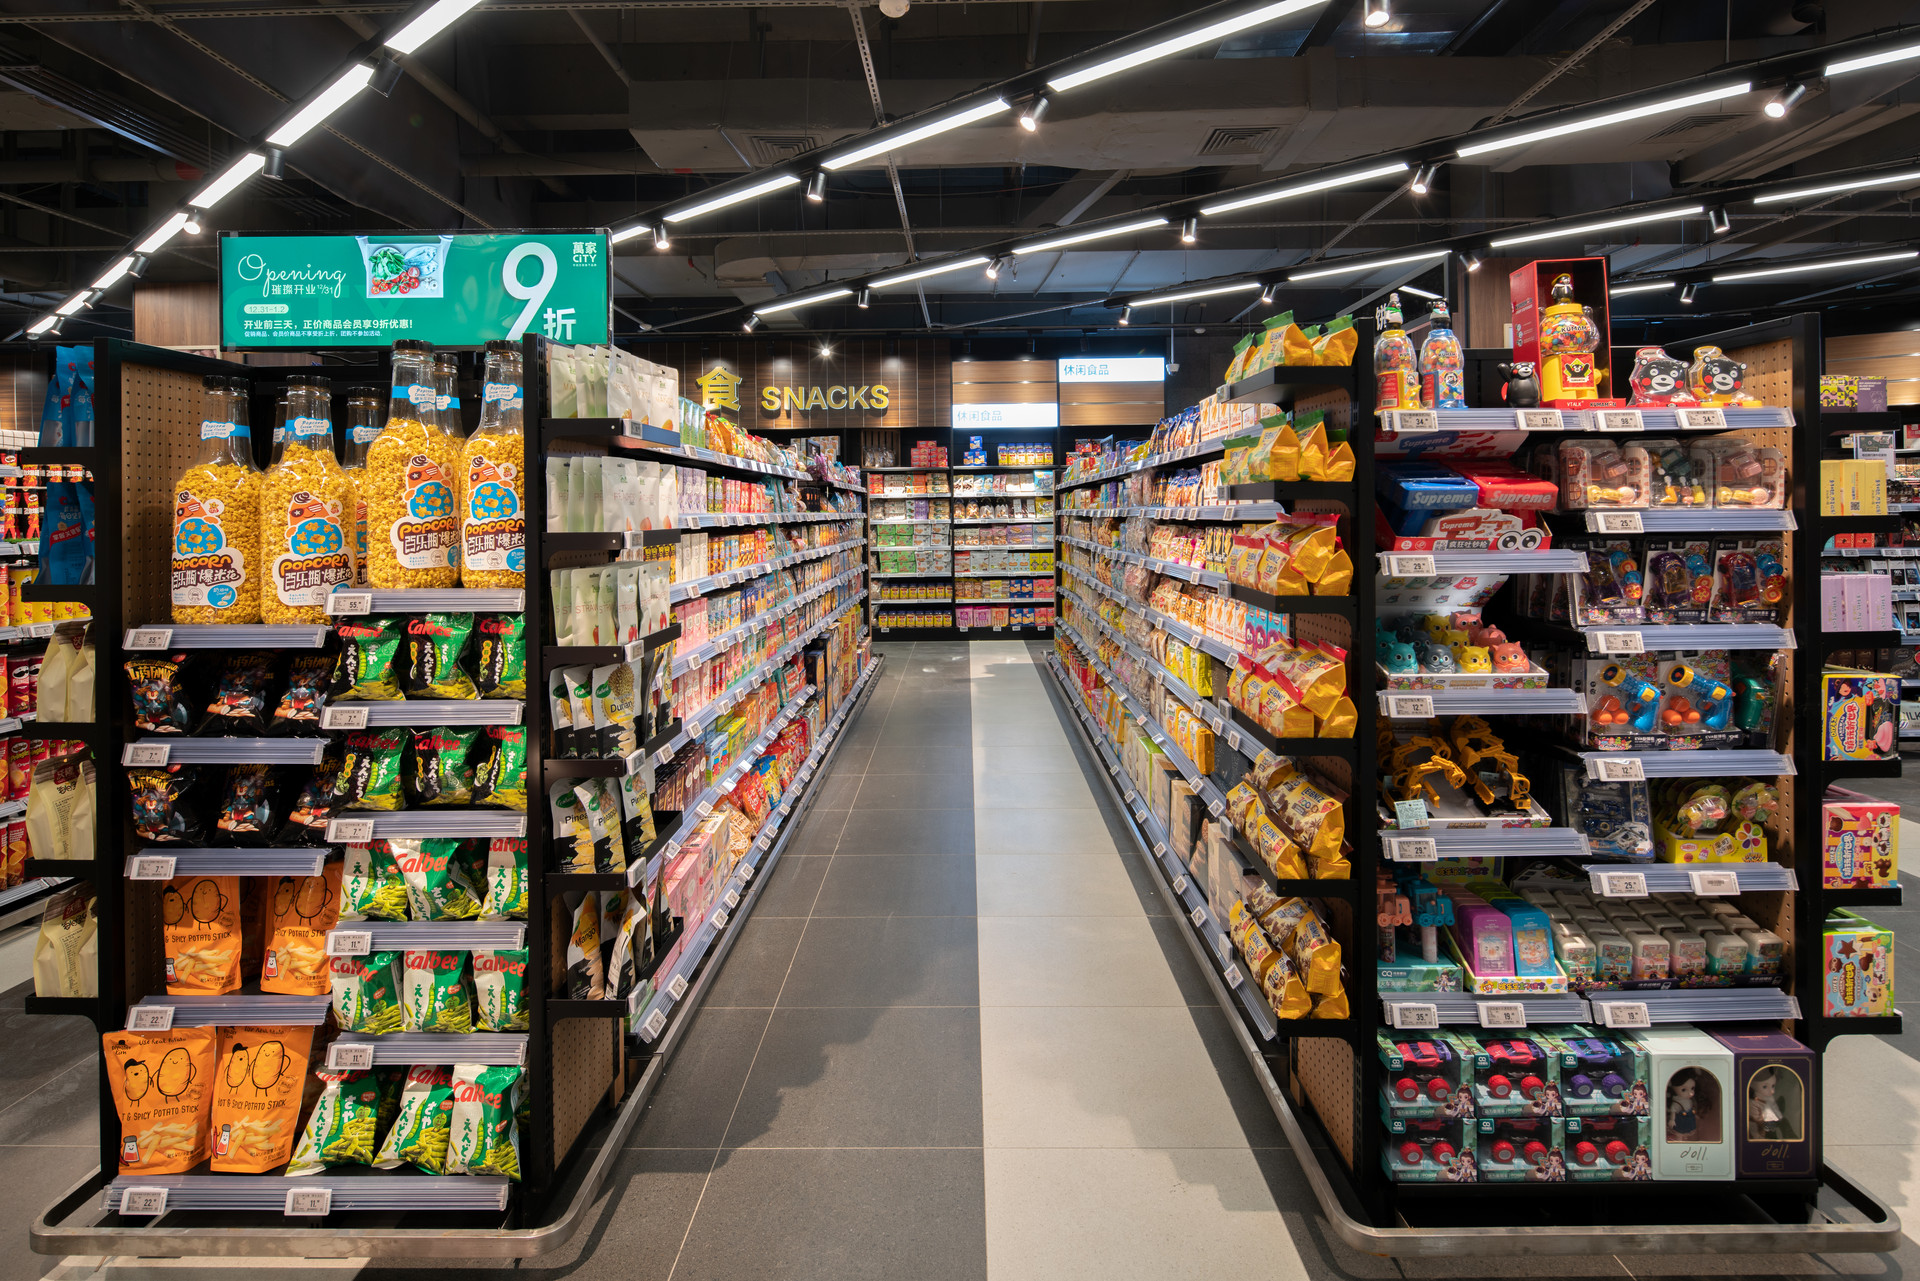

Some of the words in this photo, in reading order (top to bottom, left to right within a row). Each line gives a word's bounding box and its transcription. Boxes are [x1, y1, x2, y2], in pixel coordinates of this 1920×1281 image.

[572, 241, 597, 254] 萬家
[237, 253, 346, 298] Opening
[271, 284, 316, 295] 璀璨开业
[249, 305, 285, 313] 12.31-1.2
[1063, 364, 1110, 376] 休闲食品
[696, 366, 743, 412] 食
[761, 385, 889, 411] SNACKS
[956, 410, 1003, 422] 休闲食品
[1402, 436, 1450, 447] Supreme
[1413, 491, 1473, 505] Supreme
[1491, 490, 1551, 504] Supreme
[1441, 521, 1475, 531] Supreme
[408, 619, 456, 637] Calbee
[424, 642, 434, 685] えんどう
[441, 643, 449, 664] さや
[346, 644, 358, 686] えんどう
[610, 700, 633, 713] Durian
[347, 731, 400, 750] Calbee
[415, 735, 461, 750] Calbee
[486, 725, 522, 743] Calbee
[378, 757, 391, 778] さや
[506, 751, 515, 773] さや
[355, 756, 371, 799] えんどう
[395, 853, 448, 873] Calbee
[351, 862, 363, 912] えんどう
[431, 887, 447, 907] さや
[495, 865, 507, 915] えんどう
[171, 935, 187, 944] SPICY
[188, 934, 212, 942] POTATO
[212, 931, 232, 940] STICK
[288, 929, 310, 937] POTATO
[574, 927, 596, 947] Mango
[330, 957, 378, 982] Calbee
[405, 950, 458, 970] Calbee
[473, 955, 526, 977] Calbee
[414, 984, 422, 1031] えんどう
[435, 986, 444, 1011] さや
[487, 985, 497, 1029] えんどう
[508, 990, 517, 1013] さや
[133, 1111, 152, 1121] SPICY
[153, 1108, 179, 1118] POTATO
[181, 1105, 199, 1114] STICK
[231, 1099, 243, 1110] SPICY
[244, 1101, 266, 1110] POTATO
[267, 1099, 286, 1110] STICK
[342, 1095, 356, 1123] さや
[313, 1096, 328, 1154] えんどう
[394, 1096, 417, 1152] えんどう
[421, 1101, 437, 1129] さや
[485, 1122, 493, 1149] さや
[1680, 1147, 1707, 1161] doll
[1761, 1144, 1788, 1158] doll
